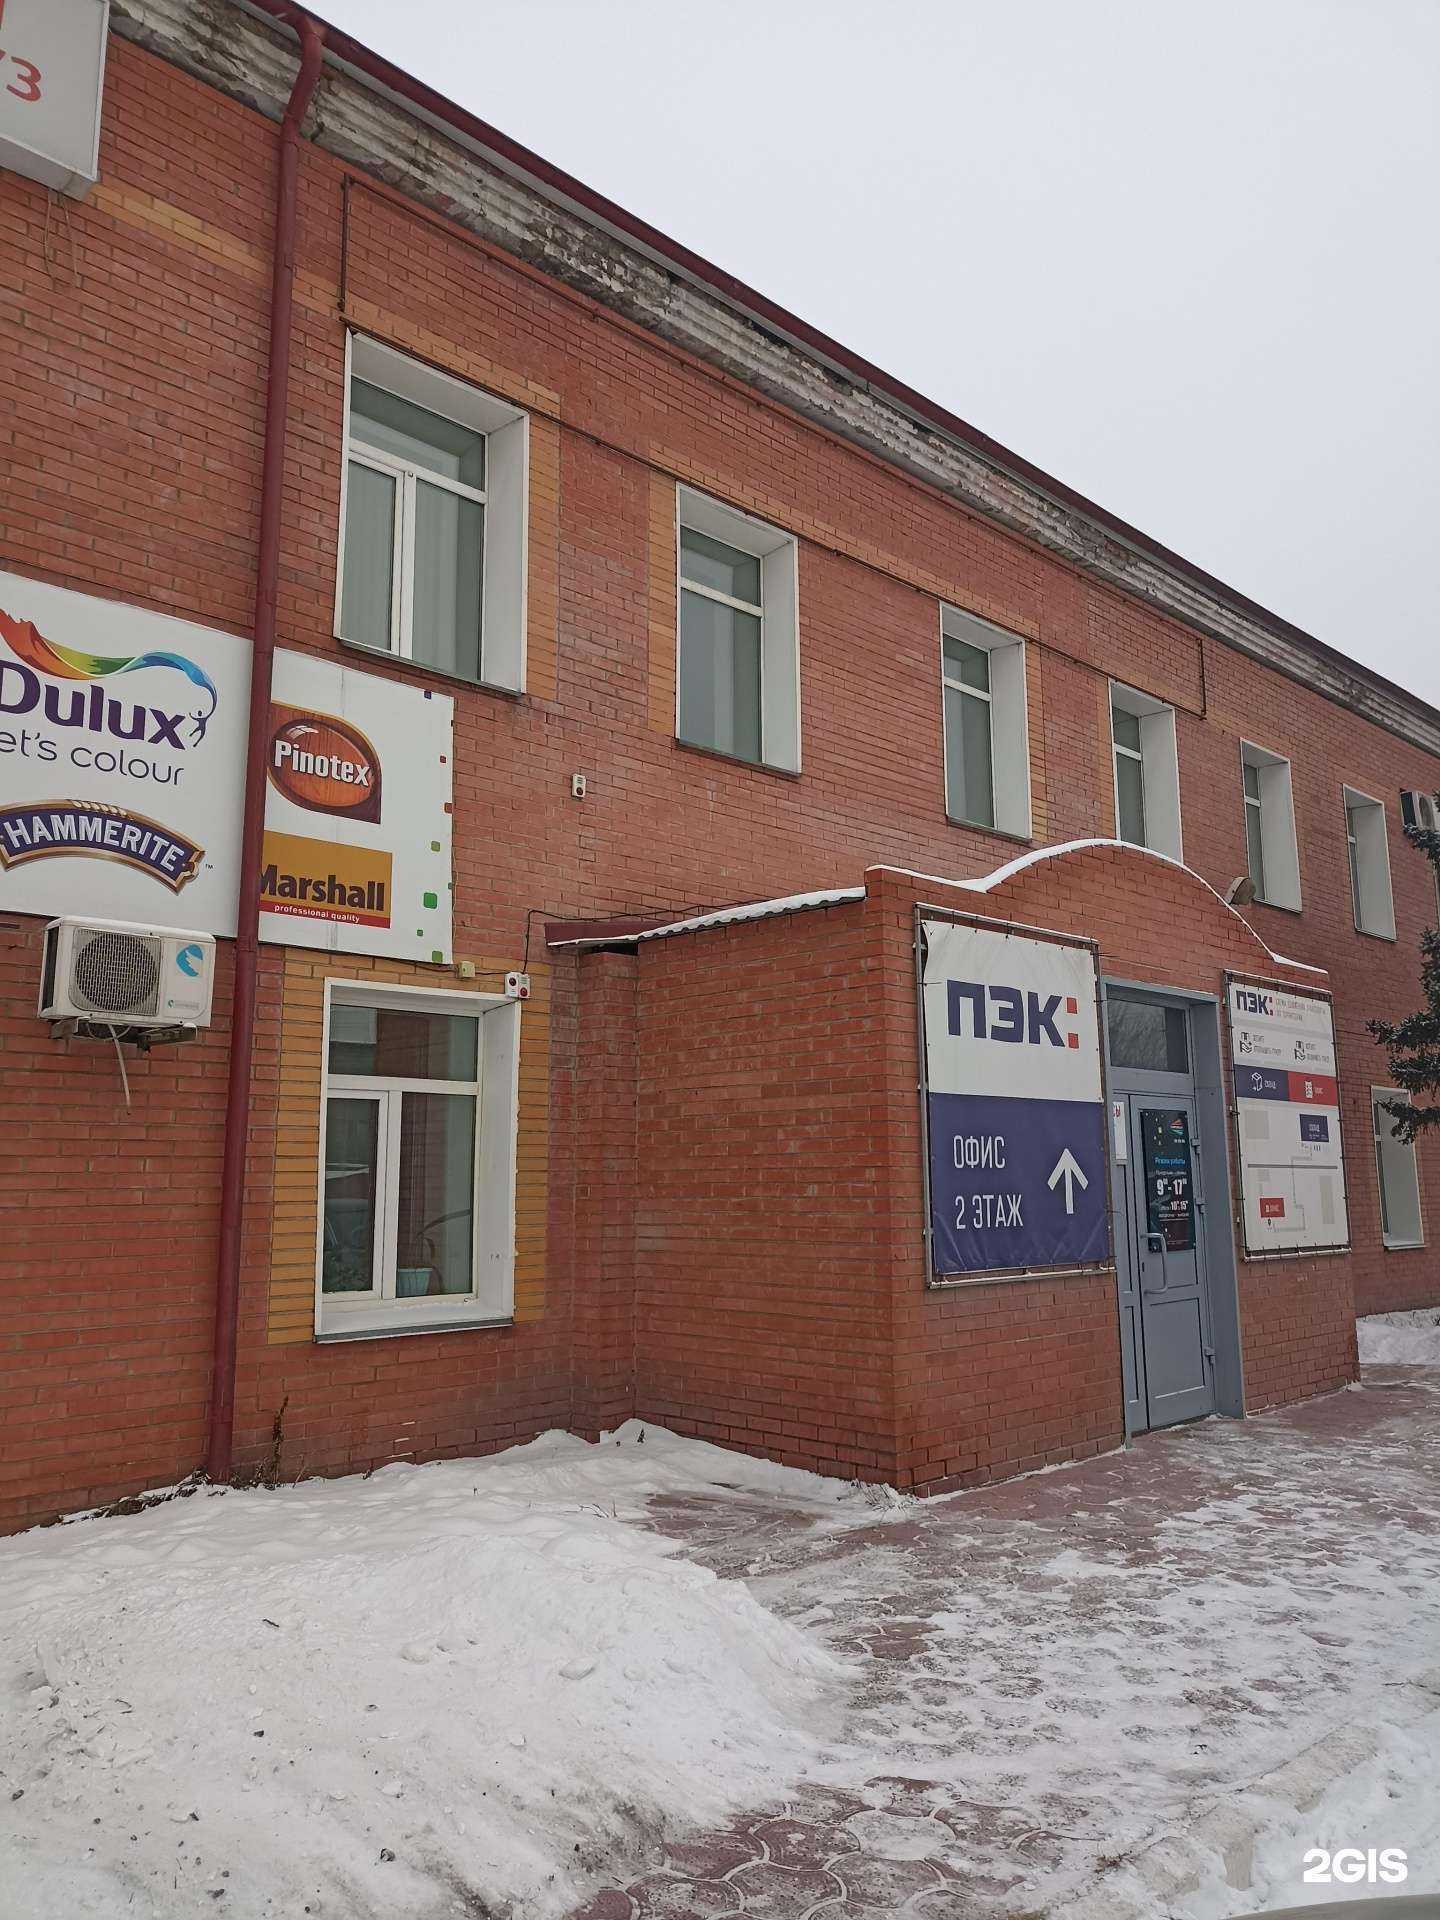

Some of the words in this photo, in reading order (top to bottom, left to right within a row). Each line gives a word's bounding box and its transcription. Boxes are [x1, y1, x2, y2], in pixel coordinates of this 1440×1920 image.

[0, 660, 185, 750] Dulux
[71, 747, 185, 785] colour
[274, 739, 370, 787] Pinotex
[3, 814, 185, 872] HAMMERITE
[260, 864, 385, 911] Marshall
[274, 904, 329, 918] professional
[331, 912, 360, 923] quality
[953, 1135, 1005, 1169] ОФИС
[955, 1195, 966, 1229] 2
[973, 1194, 1024, 1228] ЭТАЖ
